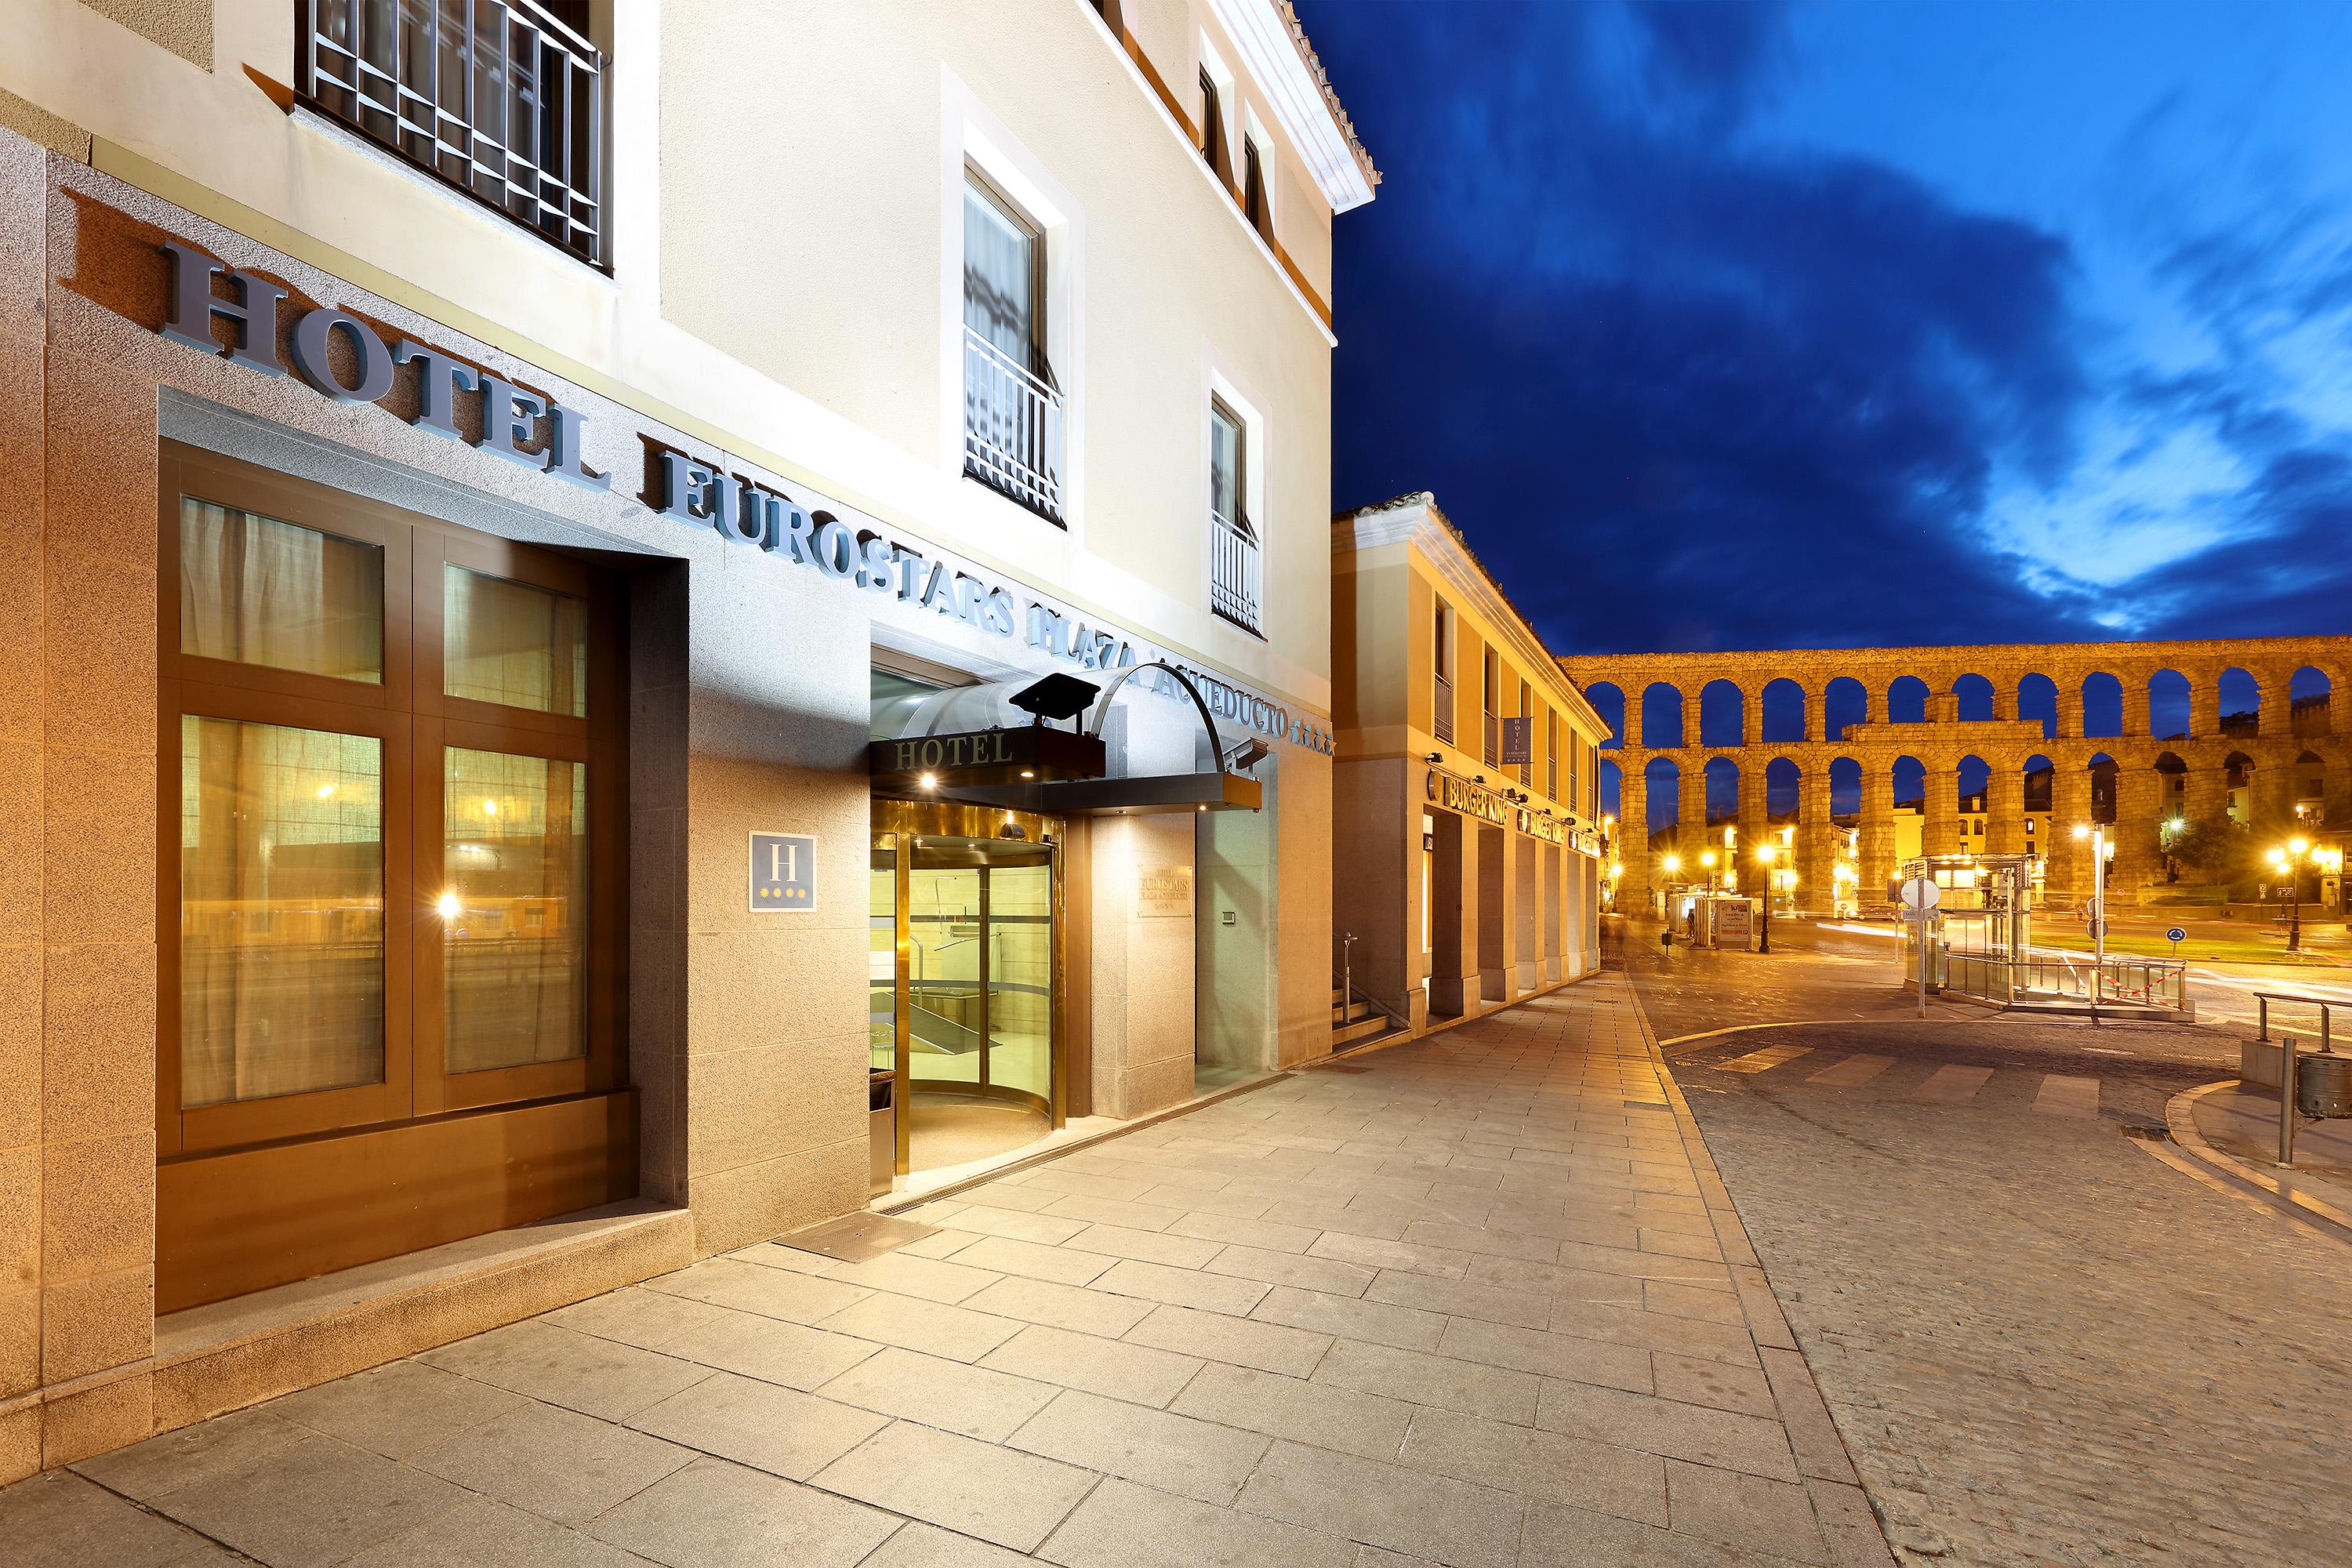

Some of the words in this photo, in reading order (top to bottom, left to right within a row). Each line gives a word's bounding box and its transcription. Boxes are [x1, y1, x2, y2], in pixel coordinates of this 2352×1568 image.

[158, 239, 612, 492] HOTEL
[659, 449, 1015, 639] EUROSTARS
[1029, 606, 1142, 686] PLAZA
[894, 733, 1013, 771] HOTEL
[1450, 778, 1487, 818] BURGER
[1489, 793, 1508, 826] KING
[1531, 813, 1552, 841] BURGER
[769, 843, 798, 882] H
